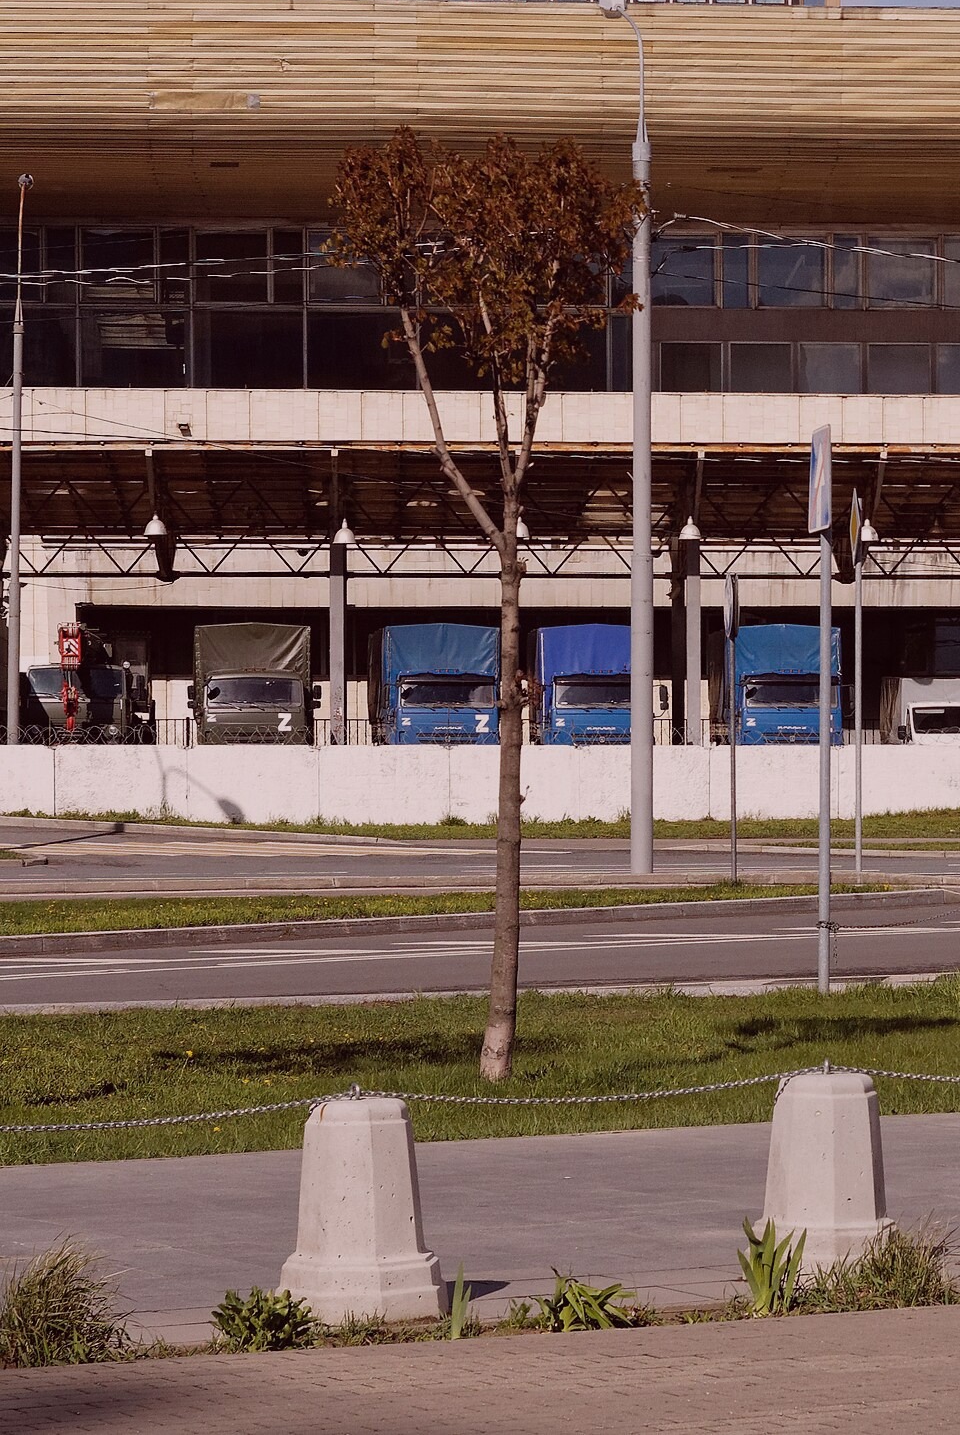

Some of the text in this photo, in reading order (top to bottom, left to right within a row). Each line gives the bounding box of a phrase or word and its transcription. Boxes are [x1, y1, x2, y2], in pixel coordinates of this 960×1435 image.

[206, 714, 217, 722] Z
[278, 713, 292, 731] Z
[401, 717, 411, 726] Z
[555, 718, 566, 726] Z
[746, 717, 756, 726] Z
[475, 714, 490, 733] Z
